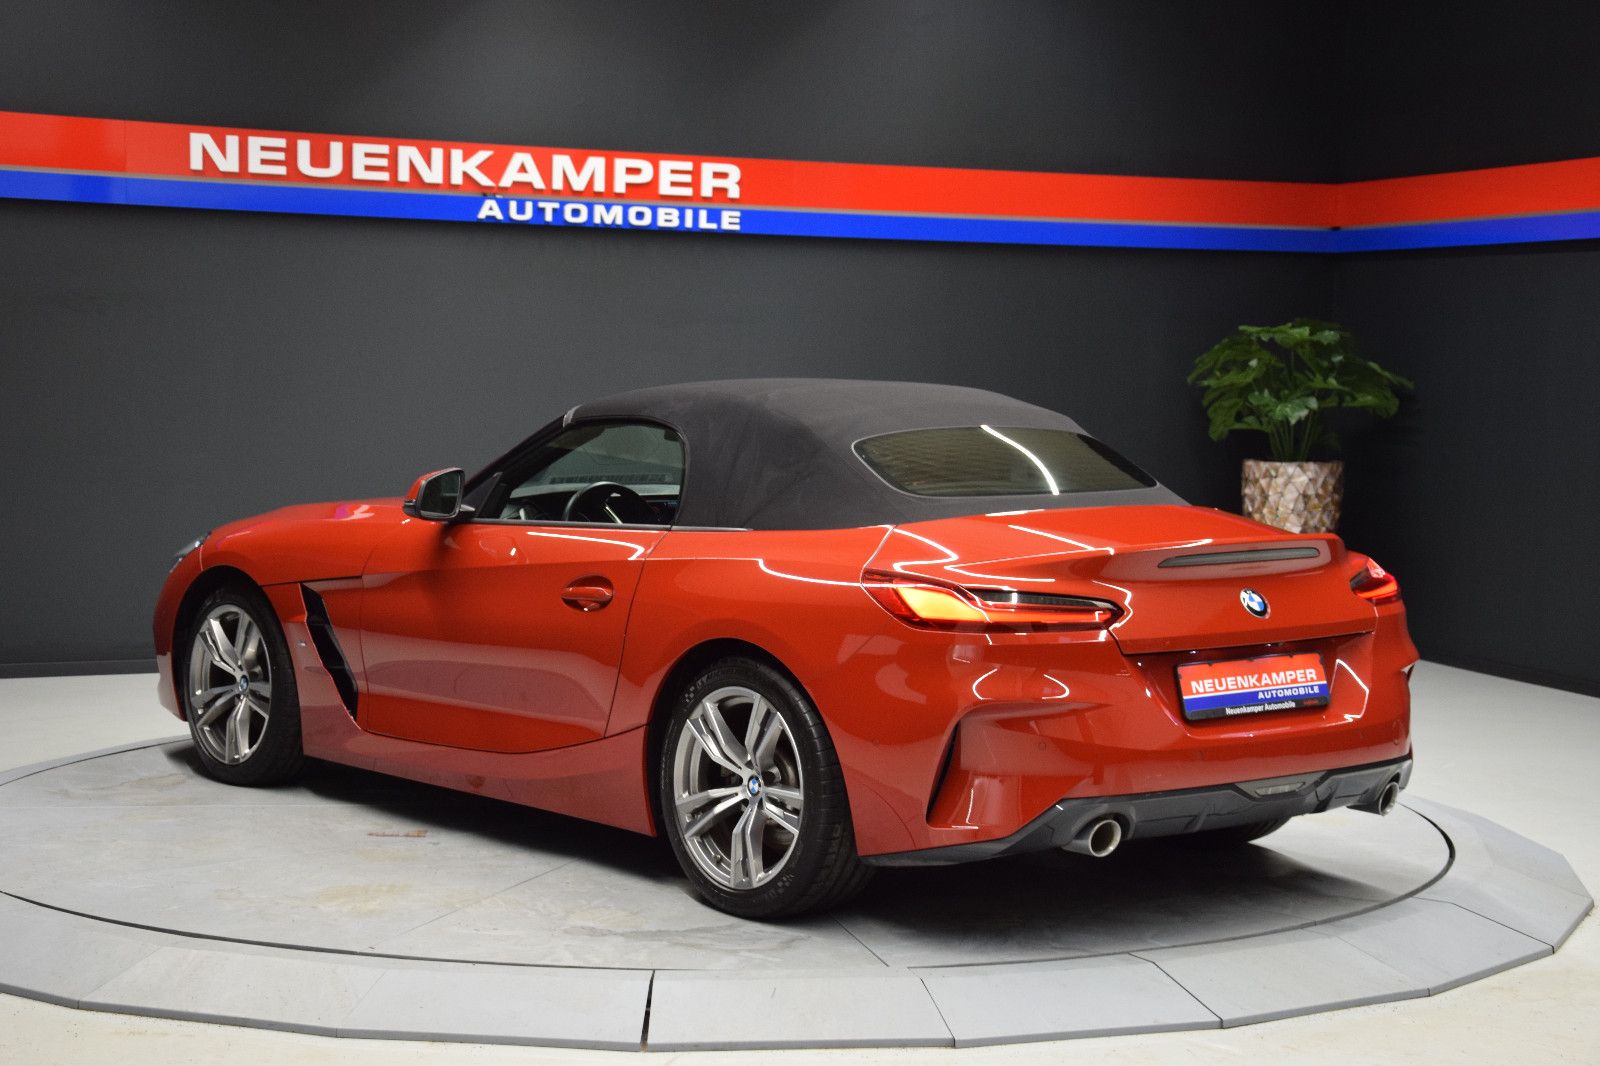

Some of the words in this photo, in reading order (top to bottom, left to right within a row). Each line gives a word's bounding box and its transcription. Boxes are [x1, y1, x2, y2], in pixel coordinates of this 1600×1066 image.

[189, 132, 742, 199] NEUENKAMPER
[477, 199, 742, 231] AUTOMOBILE
[1190, 669, 1317, 694] NEUENKAMPER
[1258, 686, 1319, 700] AUTOMOBILE
[1225, 704, 1263, 715] Neuenkamper
[1265, 701, 1296, 710] Automobile
